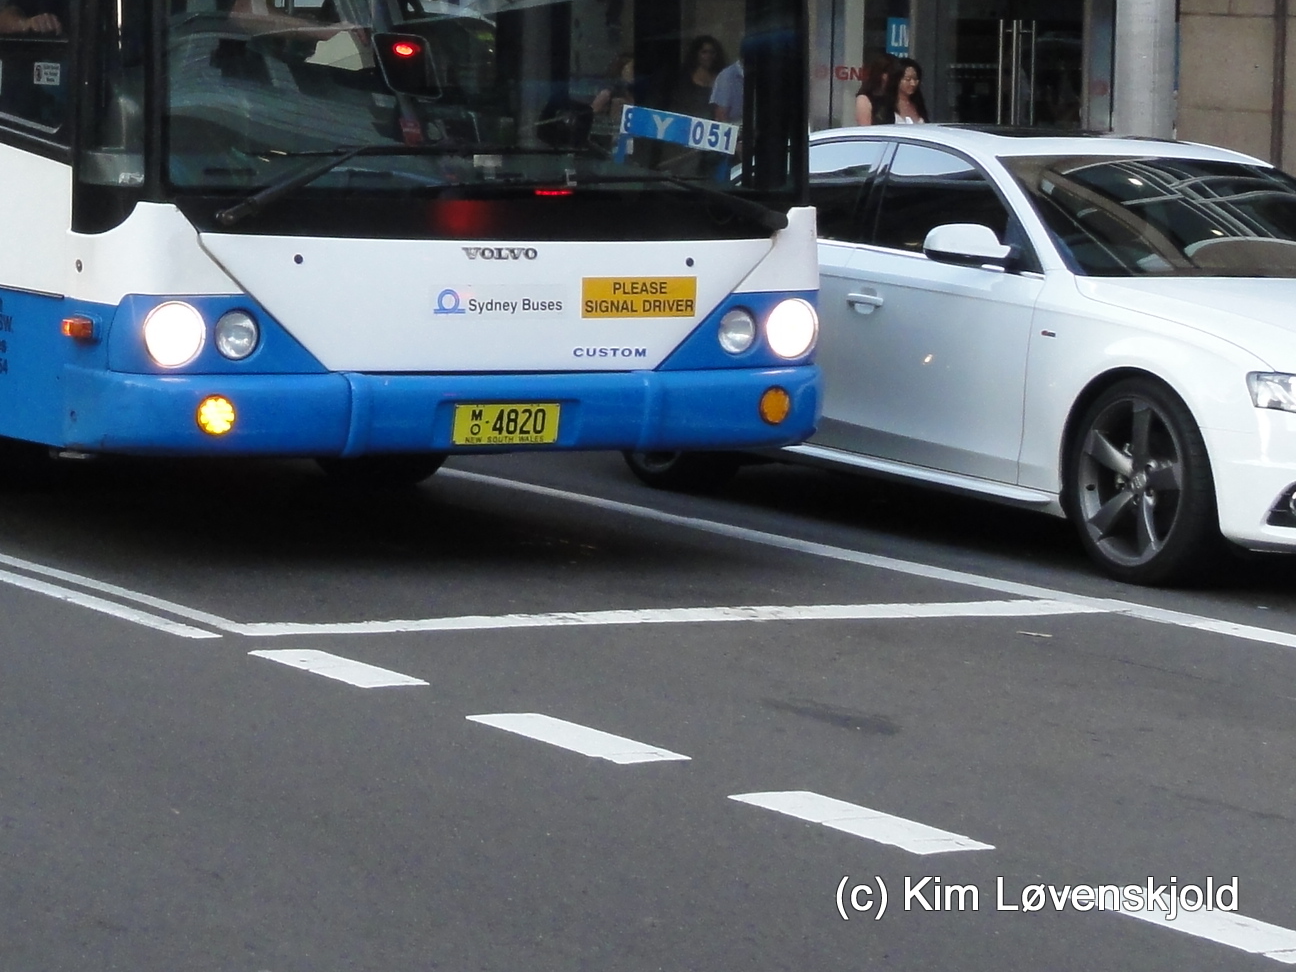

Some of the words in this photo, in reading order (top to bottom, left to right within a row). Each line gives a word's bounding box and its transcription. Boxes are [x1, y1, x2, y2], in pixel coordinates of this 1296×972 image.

[691, 121, 733, 151] 051
[462, 247, 538, 261] VOLVO
[612, 282, 668, 295] PLEASE
[468, 299, 517, 314] Sydney
[522, 299, 563, 312] Buses
[584, 300, 638, 314] SIGNAL
[642, 299, 695, 313] DRIVER
[573, 347, 647, 357] CUSTOM
[487, 435, 514, 443] SOUTH
